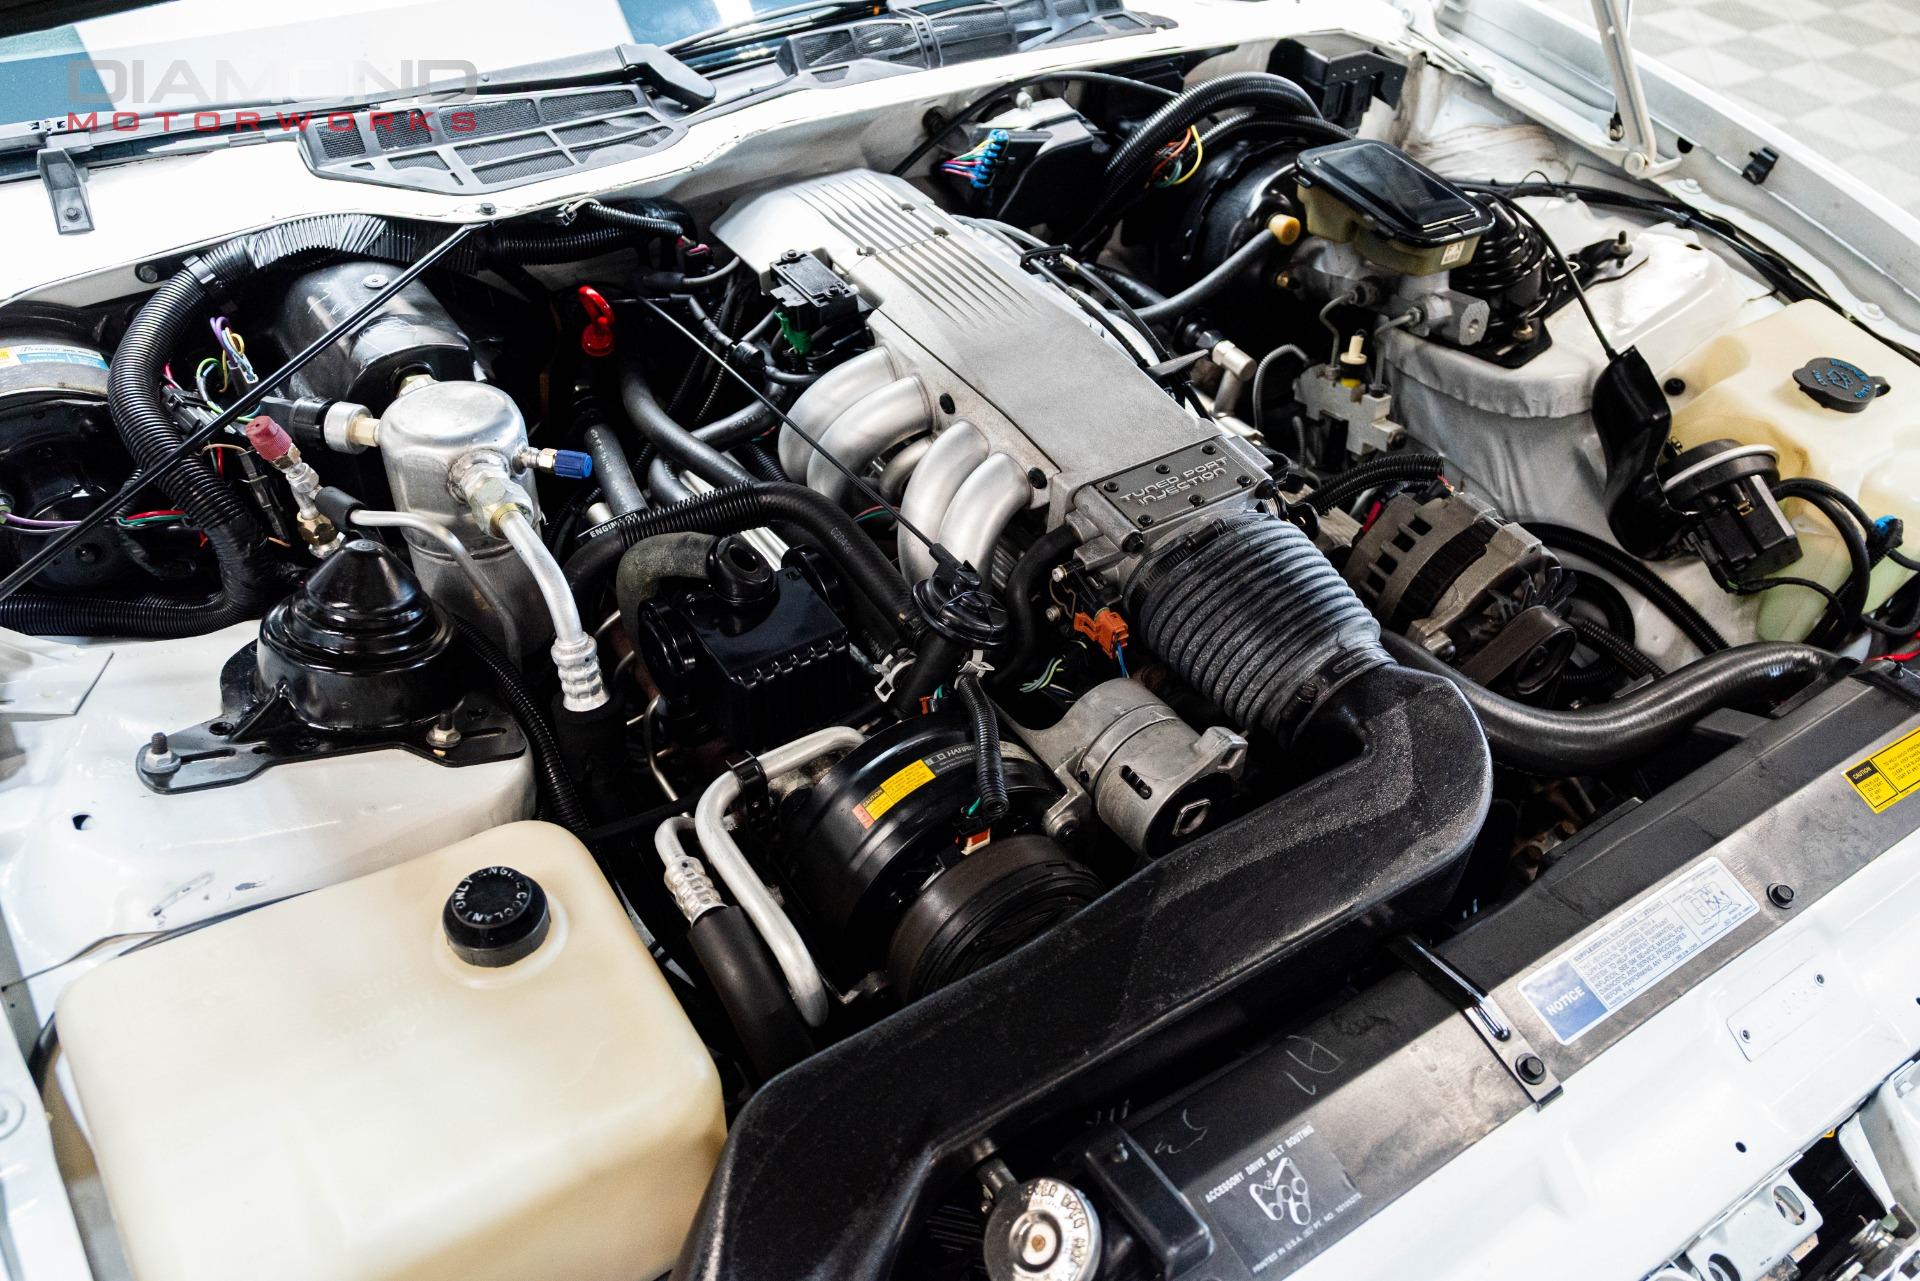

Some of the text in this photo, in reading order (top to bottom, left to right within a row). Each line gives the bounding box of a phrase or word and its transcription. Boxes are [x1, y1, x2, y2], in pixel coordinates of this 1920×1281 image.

[1120, 457, 1227, 501] TUNED PORT
[1138, 467, 1227, 505] INJECTION
[1852, 766, 1873, 779] CAUTION
[455, 875, 473, 909] ONLY
[1544, 984, 1586, 1017] NOTICE
[1205, 1125, 1315, 1203] ACCESSORY DRIVE BELT ROUTING
